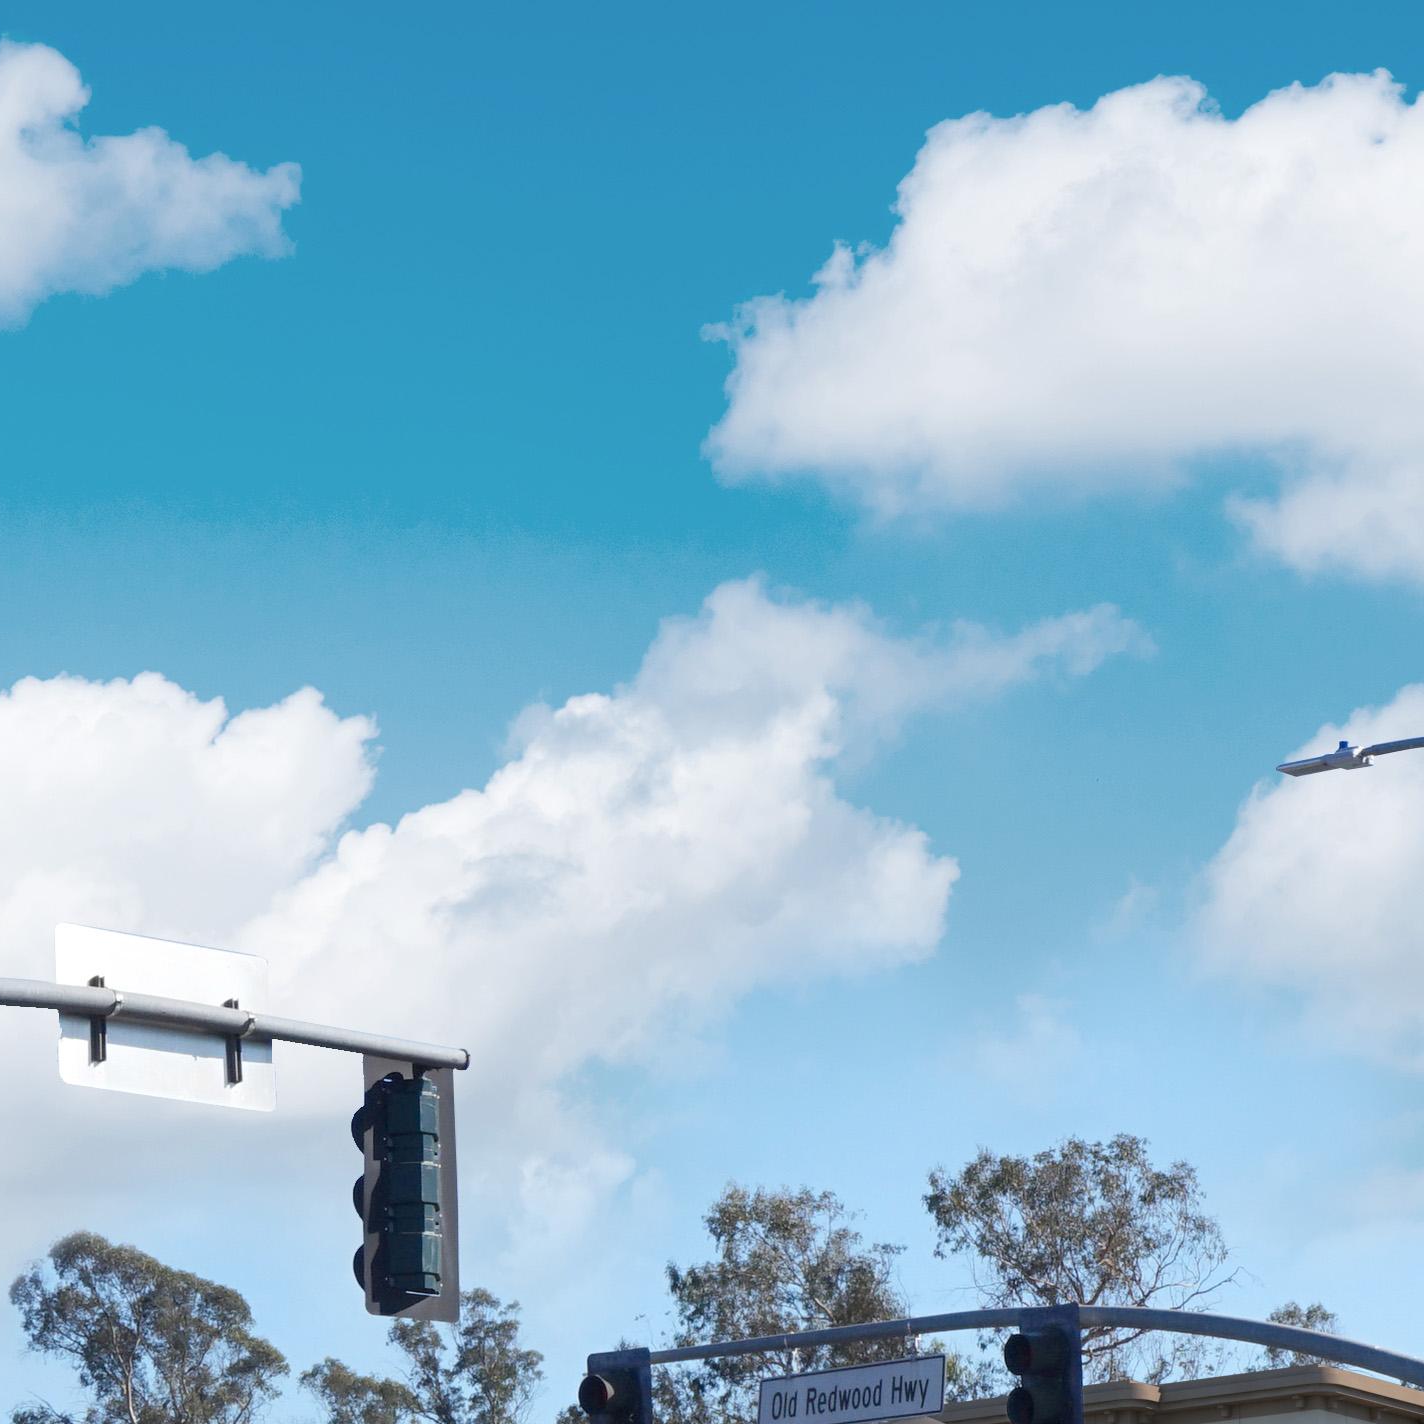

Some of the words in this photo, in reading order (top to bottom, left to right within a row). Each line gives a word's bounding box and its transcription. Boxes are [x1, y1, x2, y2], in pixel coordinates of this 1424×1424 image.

[771, 1390, 798, 1421] Old
[805, 1378, 884, 1416] Redwood
[890, 1374, 930, 1409] Hwy
